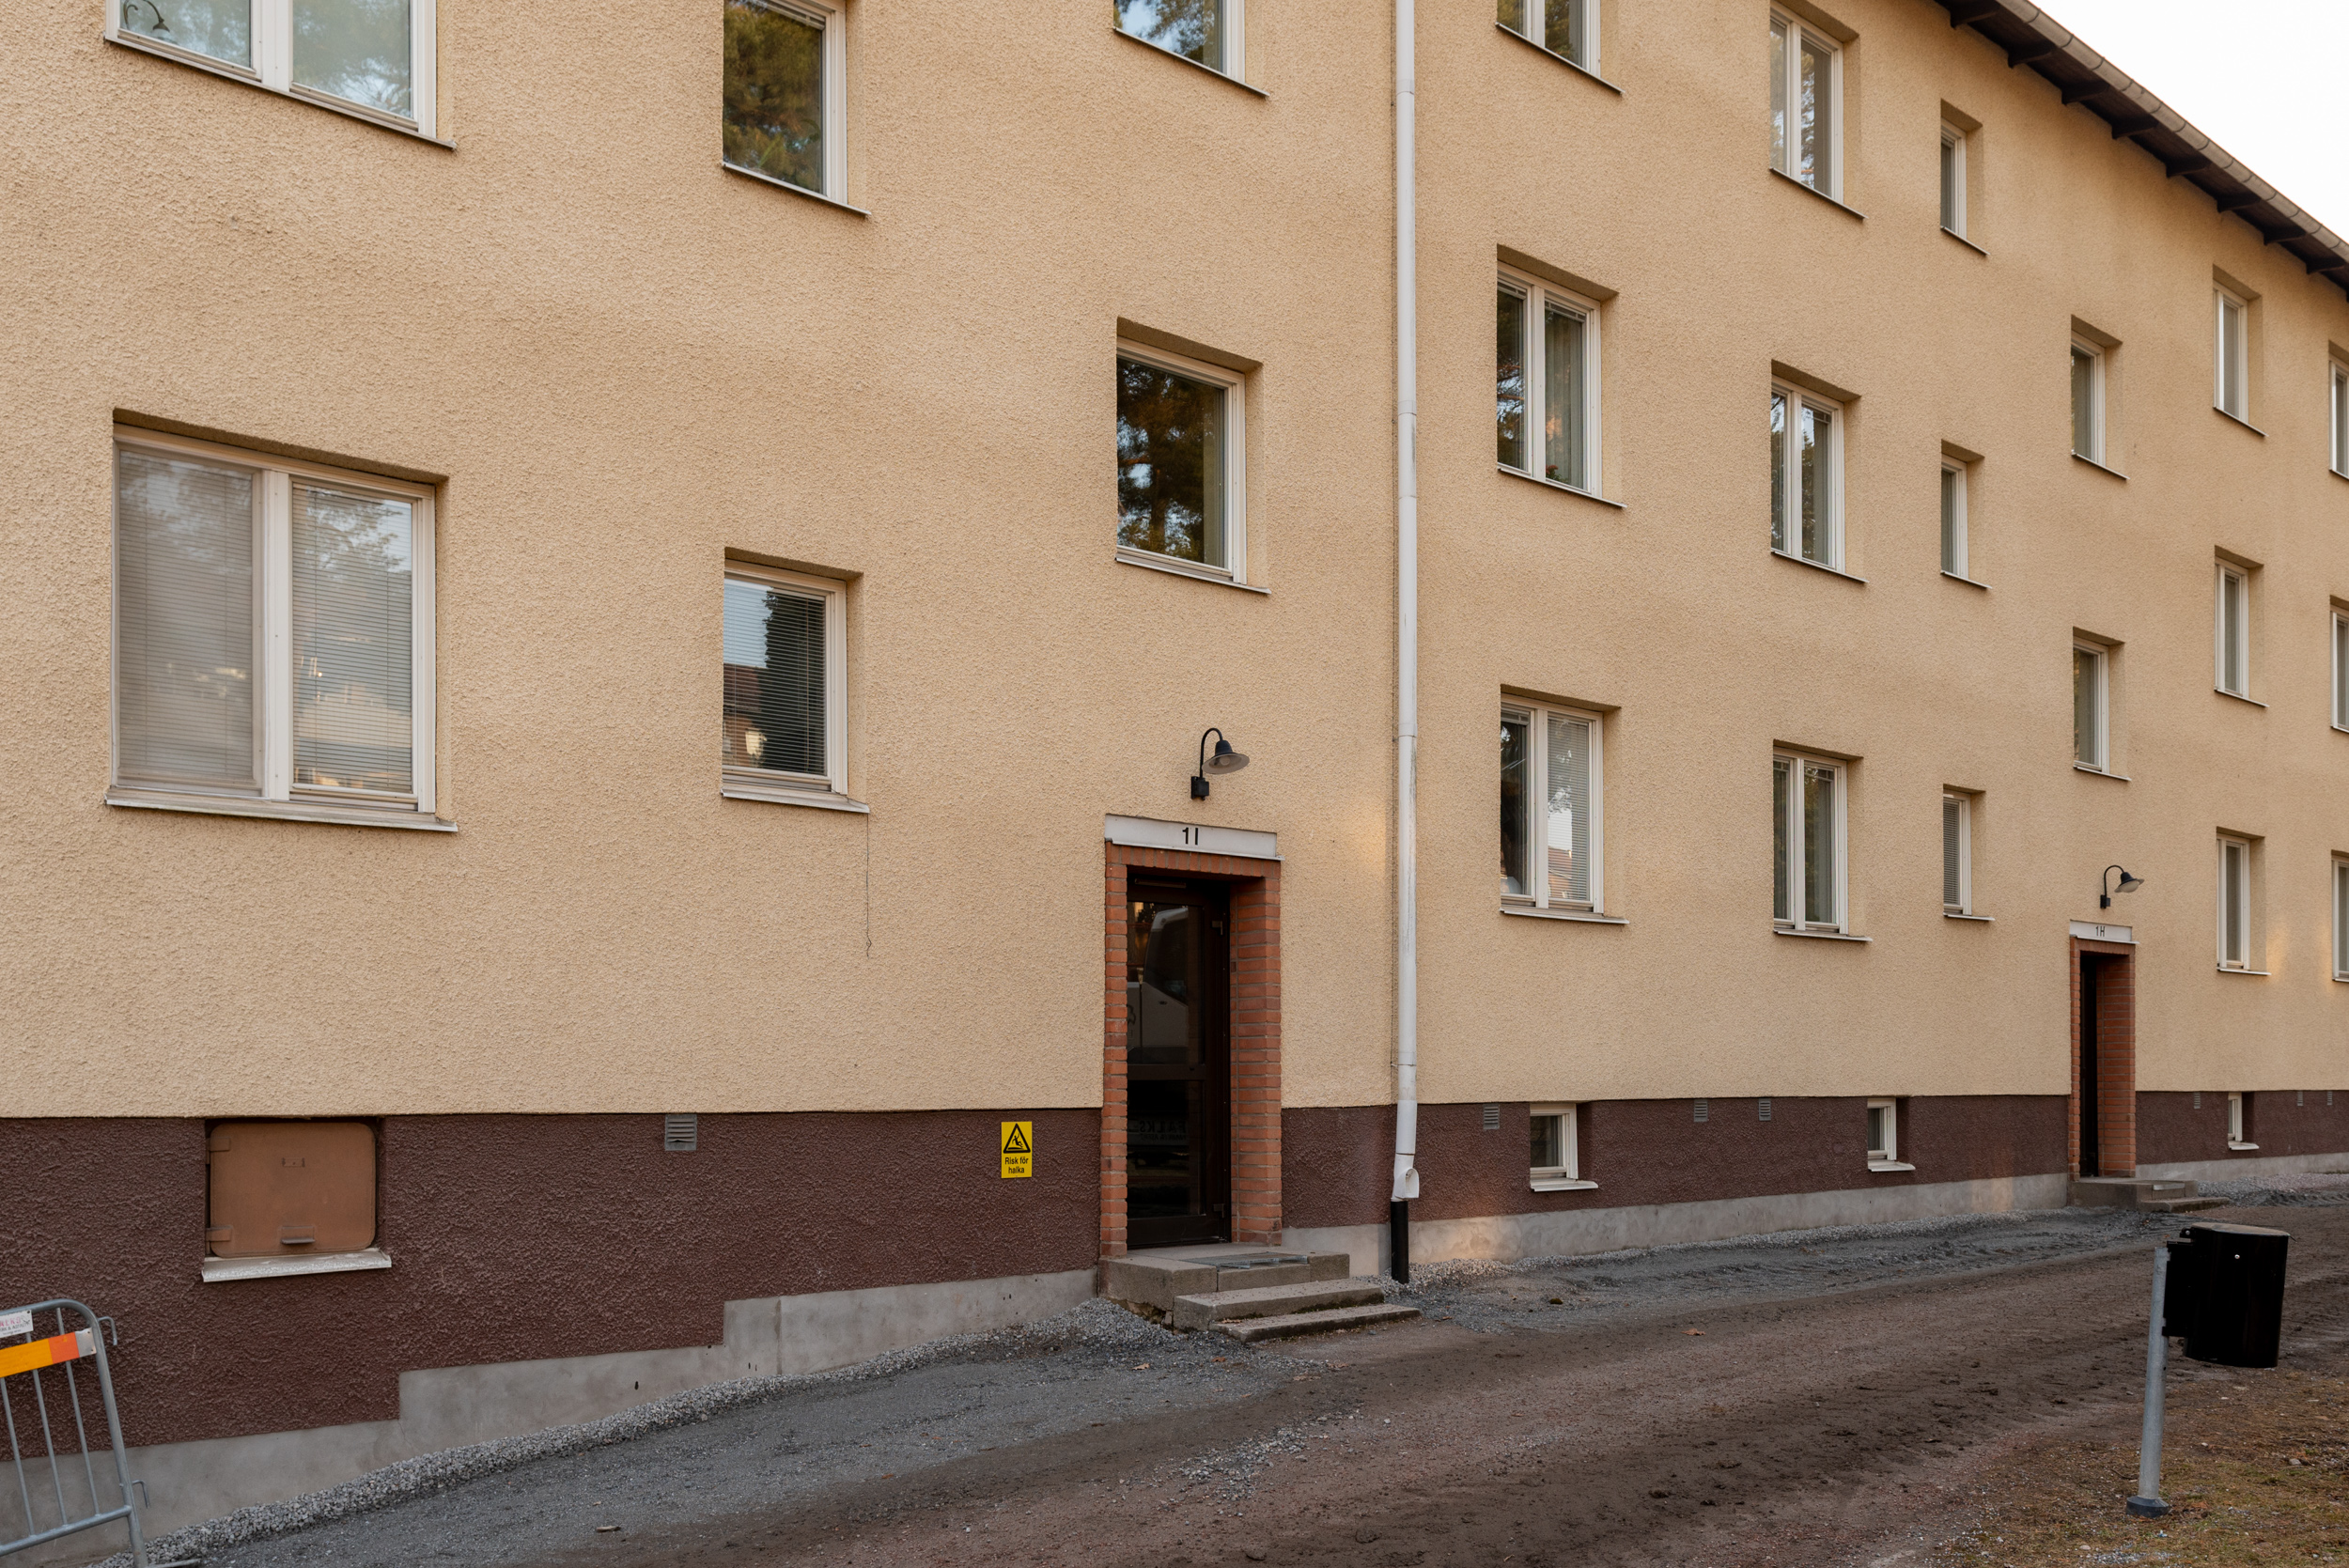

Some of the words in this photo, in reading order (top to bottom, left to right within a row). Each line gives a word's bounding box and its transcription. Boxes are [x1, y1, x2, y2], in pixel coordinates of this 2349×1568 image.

[2095, 925, 2106, 937] 1H
[1004, 1157, 1019, 1165] Risk
[1008, 1166, 1025, 1174] halka
